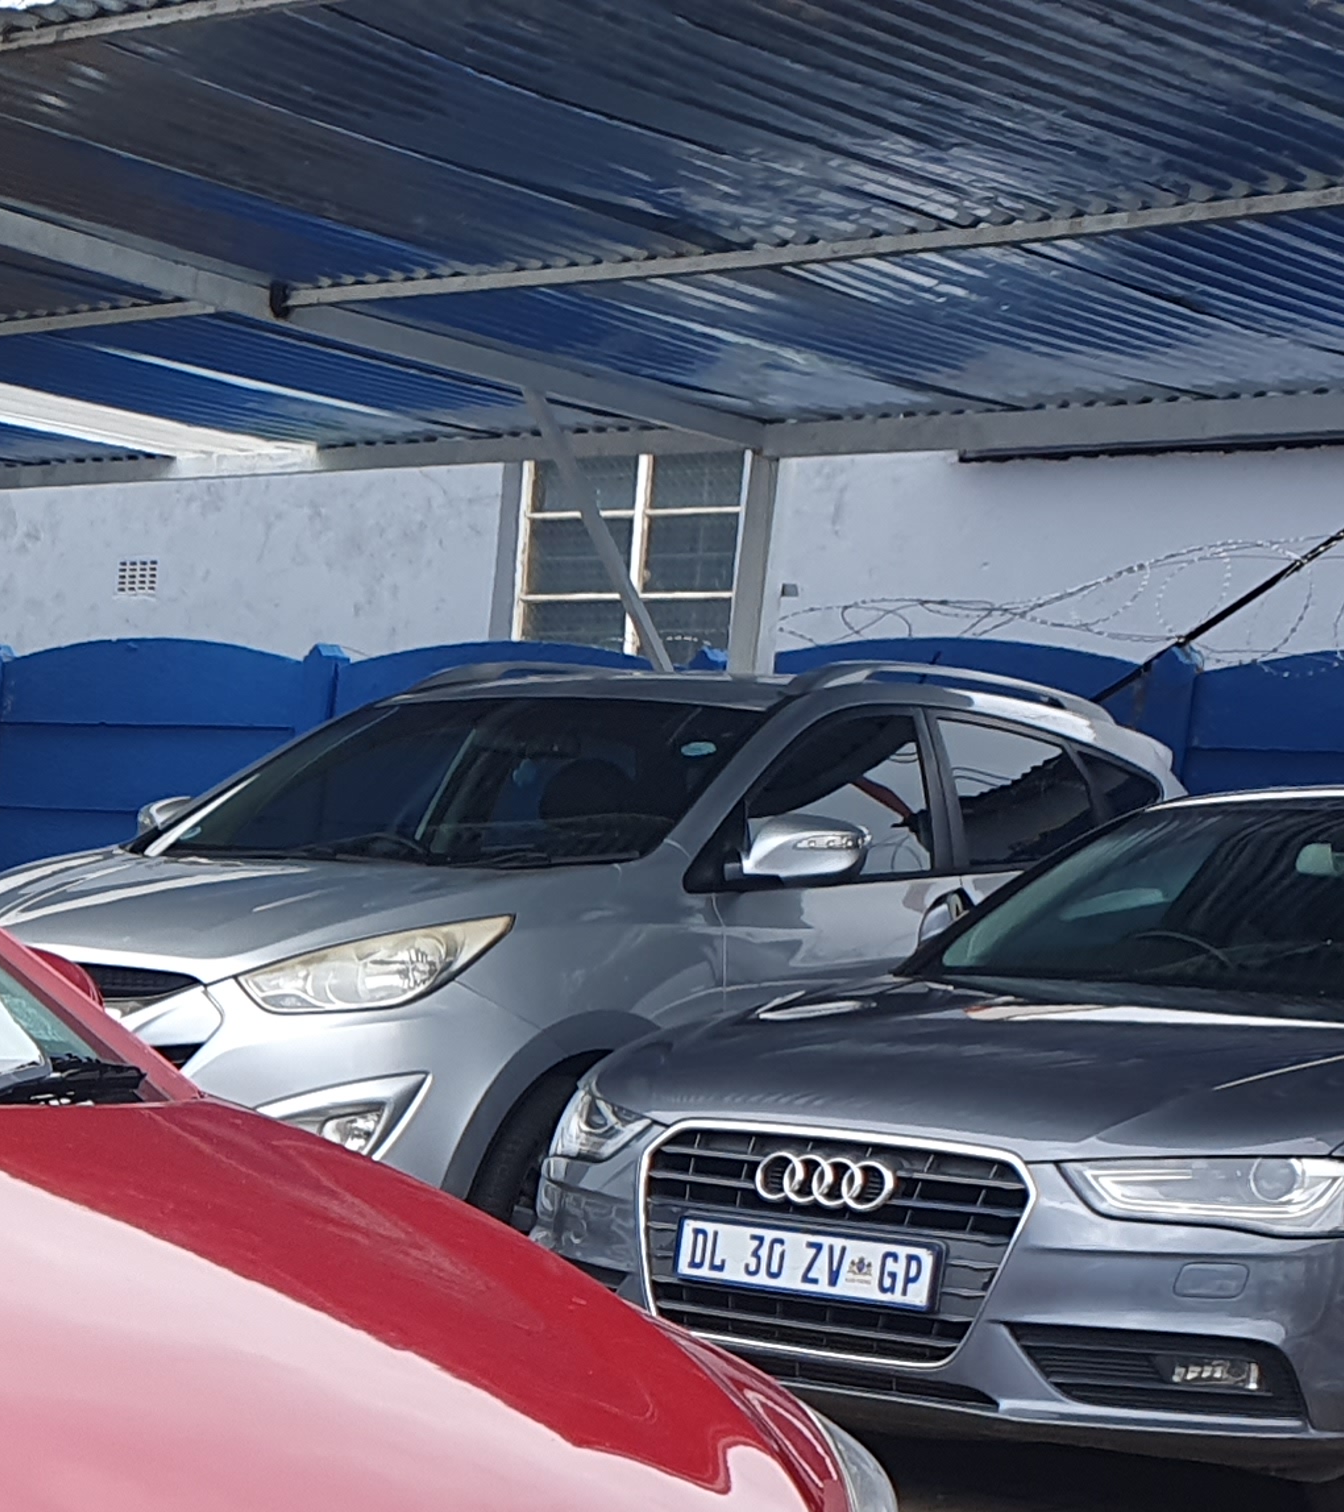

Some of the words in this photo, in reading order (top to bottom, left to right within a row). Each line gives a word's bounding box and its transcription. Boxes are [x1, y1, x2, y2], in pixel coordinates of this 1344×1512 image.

[687, 1228, 727, 1272] DL
[743, 1234, 786, 1280] 30
[800, 1241, 847, 1288] ZV
[877, 1250, 923, 1297] GP
